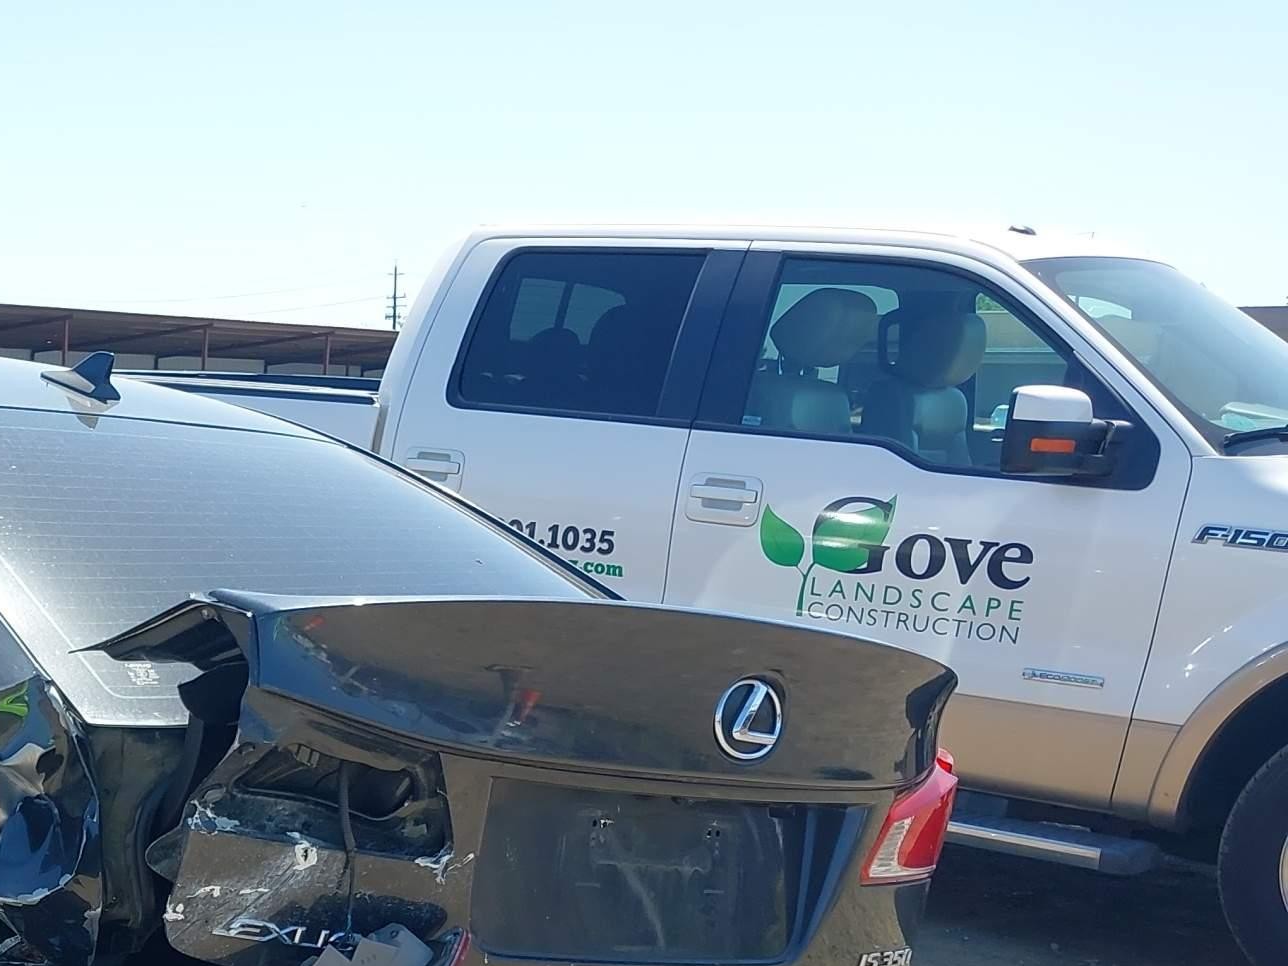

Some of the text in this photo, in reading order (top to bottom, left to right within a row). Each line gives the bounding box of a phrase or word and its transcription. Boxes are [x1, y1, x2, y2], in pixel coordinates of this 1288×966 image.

[813, 496, 1034, 590] Gove
[1191, 523, 1288, 553] F-150
[810, 577, 1025, 621] LANDSCAPE
[807, 601, 1020, 645] CONSTRUCTION
